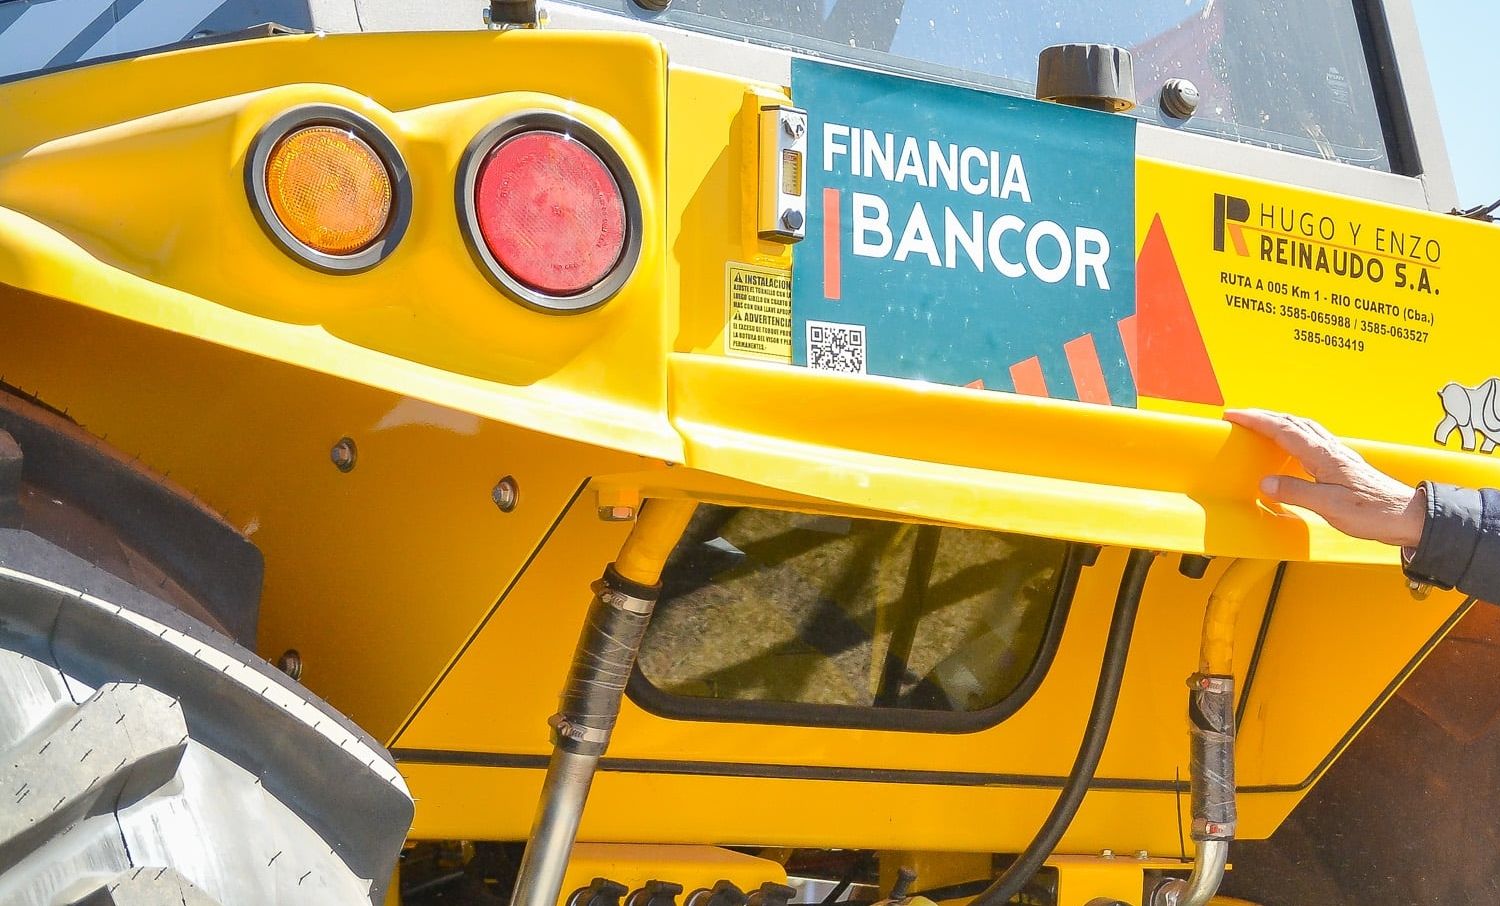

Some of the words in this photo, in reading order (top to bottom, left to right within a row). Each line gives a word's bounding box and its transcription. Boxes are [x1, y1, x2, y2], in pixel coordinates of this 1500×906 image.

[823, 121, 1032, 204] FINANCIA
[852, 191, 1112, 291] BANCOR
[1260, 202, 1335, 241] HUGO
[1349, 221, 1361, 247] Y
[1375, 227, 1441, 263] ENZO
[1260, 234, 1384, 283] REINAUDO
[1394, 262, 1440, 296] S.A.
[744, 312, 792, 328] ADVERTENCIA
[1220, 271, 1252, 289] RUTA
[1255, 278, 1264, 290] A
[1267, 280, 1288, 295] 005
[1291, 285, 1310, 300] Km
[1314, 289, 1319, 301] 1
[1331, 293, 1351, 307] RIO
[1354, 297, 1400, 317] CUARTO
[1403, 307, 1434, 327] (Cba.)
[1225, 293, 1276, 315] VENTAS:
[1279, 304, 1351, 329] 3585-065988
[1360, 319, 1429, 344] 3585-063527
[1293, 328, 1365, 352] 3585-063419
